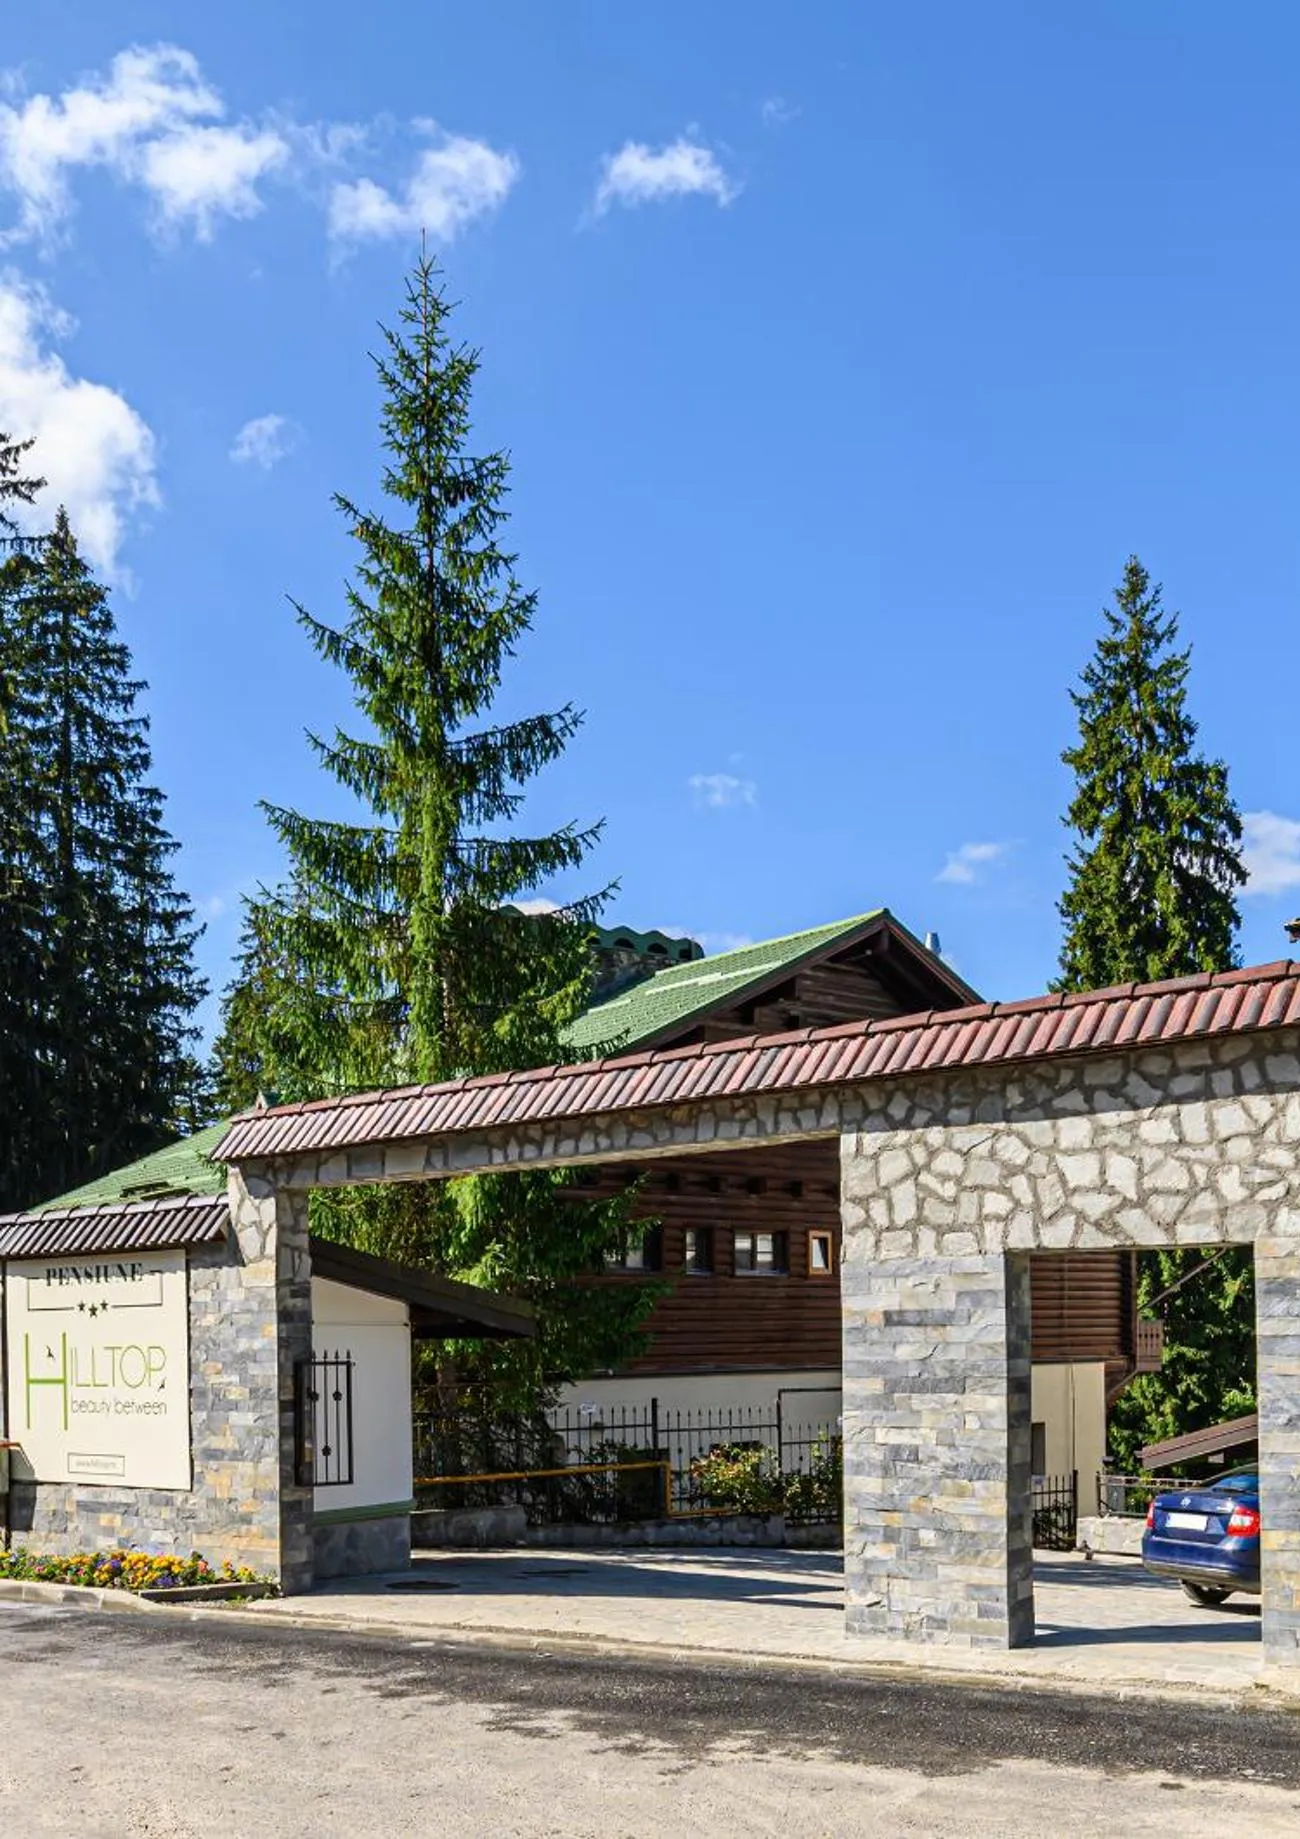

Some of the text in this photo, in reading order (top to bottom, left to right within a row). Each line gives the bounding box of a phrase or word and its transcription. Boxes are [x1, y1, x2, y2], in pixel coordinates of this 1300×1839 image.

[45, 1262, 144, 1287] PENSIUNE
[25, 1331, 167, 1431] HILLTOP
[114, 1398, 167, 1416] between
